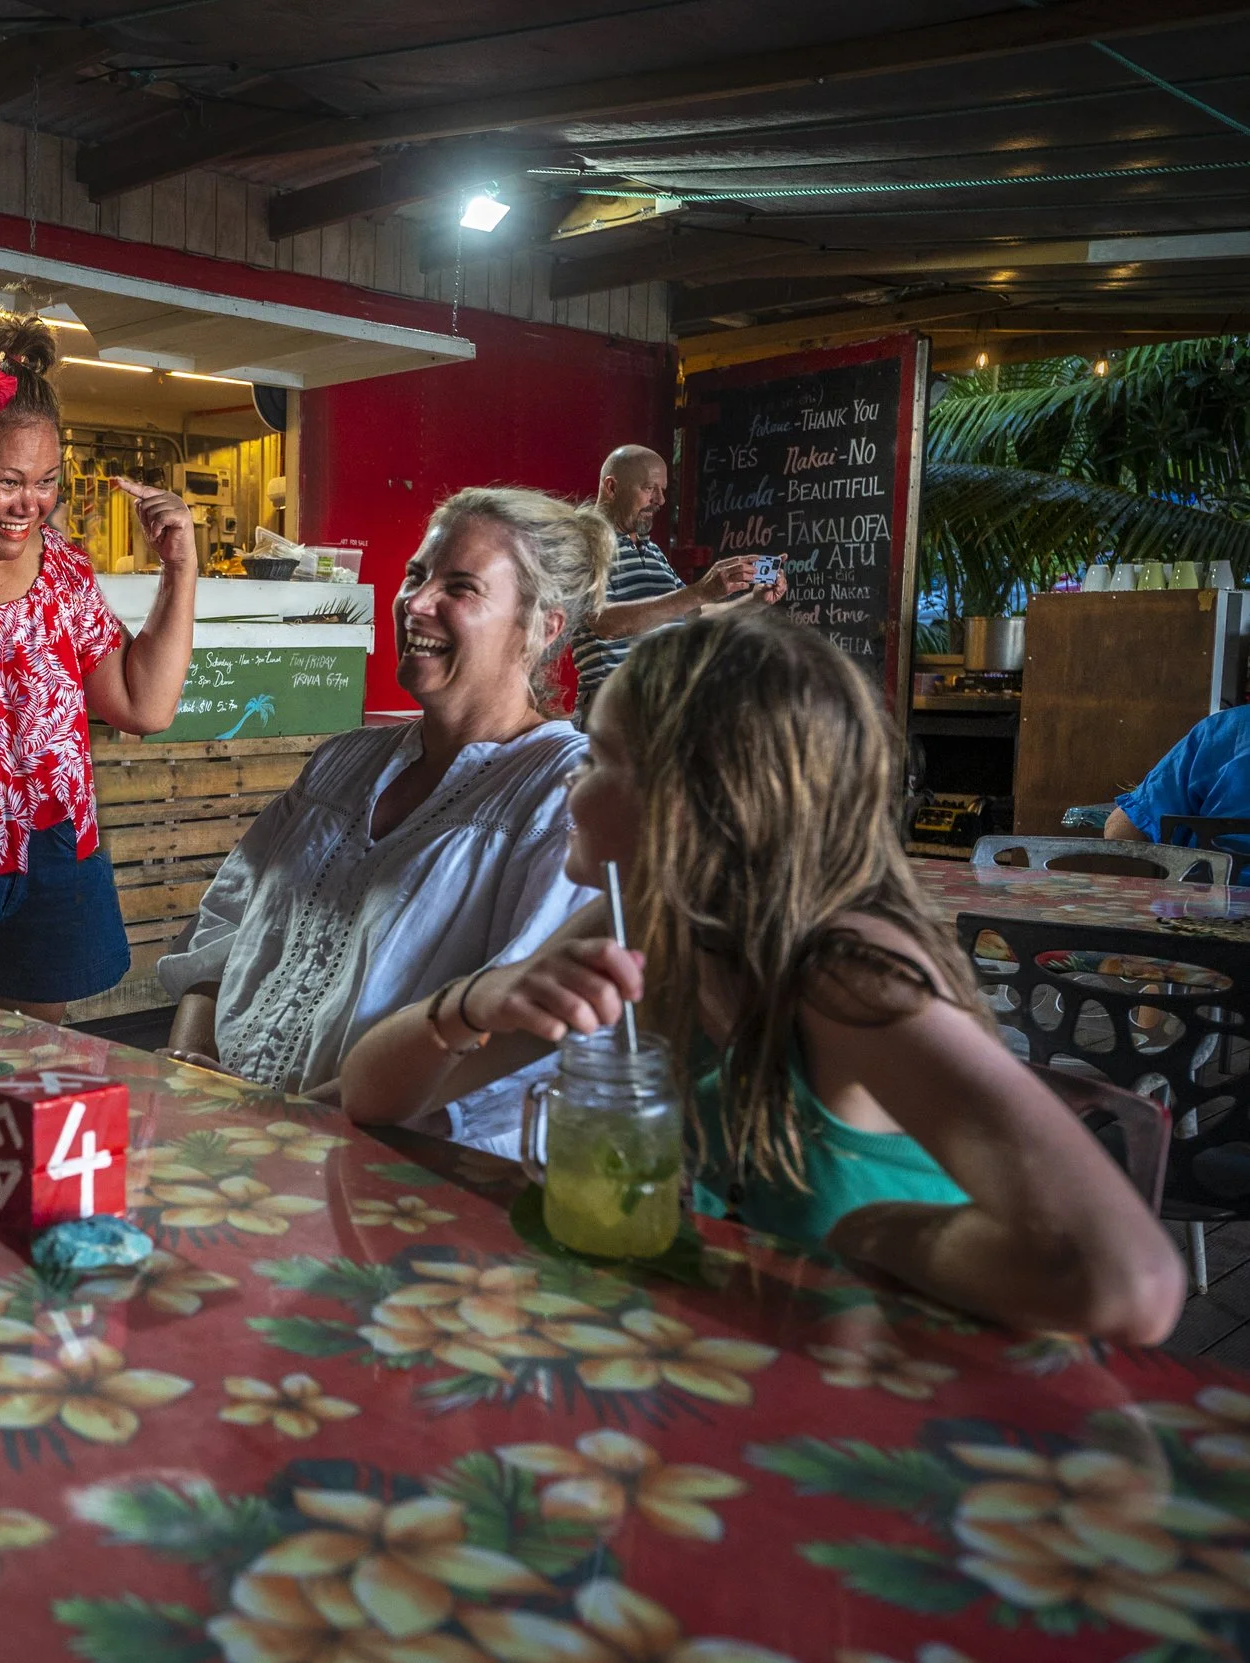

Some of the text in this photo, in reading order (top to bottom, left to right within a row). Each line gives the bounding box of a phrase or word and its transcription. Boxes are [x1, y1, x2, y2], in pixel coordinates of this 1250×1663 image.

[853, 398, 880, 424] YOU
[826, 543, 877, 570] ATU
[46, 1100, 113, 1218] 4
